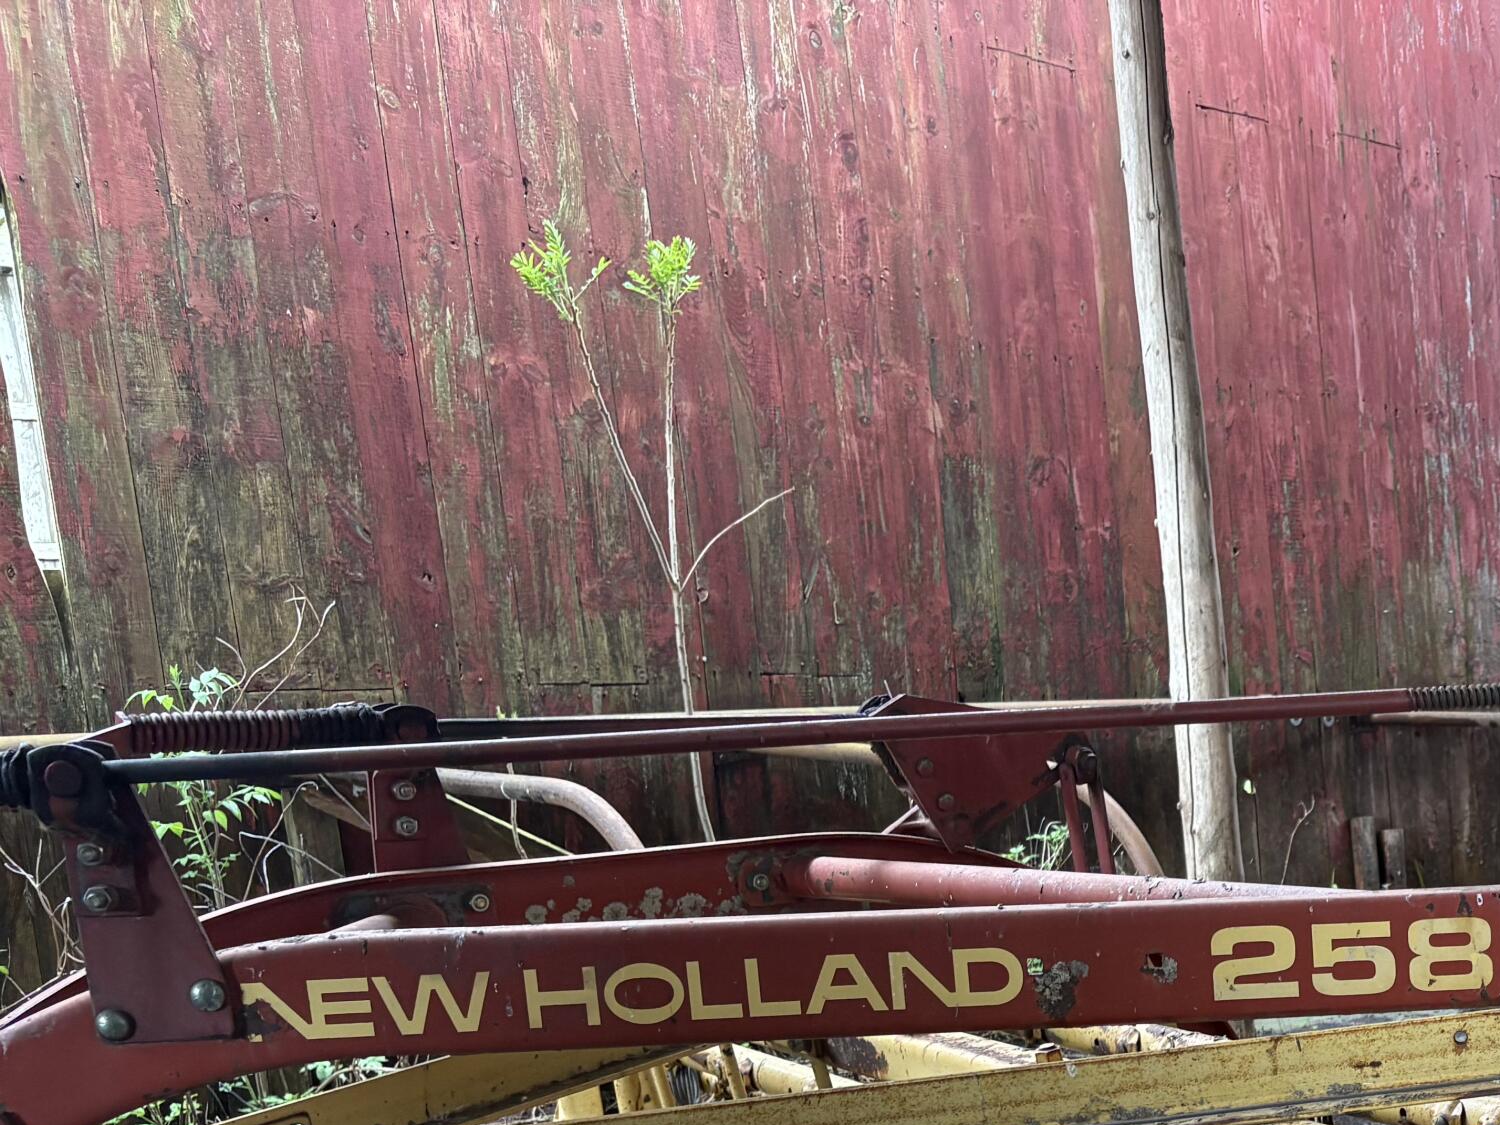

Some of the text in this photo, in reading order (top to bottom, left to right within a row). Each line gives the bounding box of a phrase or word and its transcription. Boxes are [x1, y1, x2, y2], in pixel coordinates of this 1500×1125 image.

[239, 917, 1494, 1043] NEW HOLLAND 258
